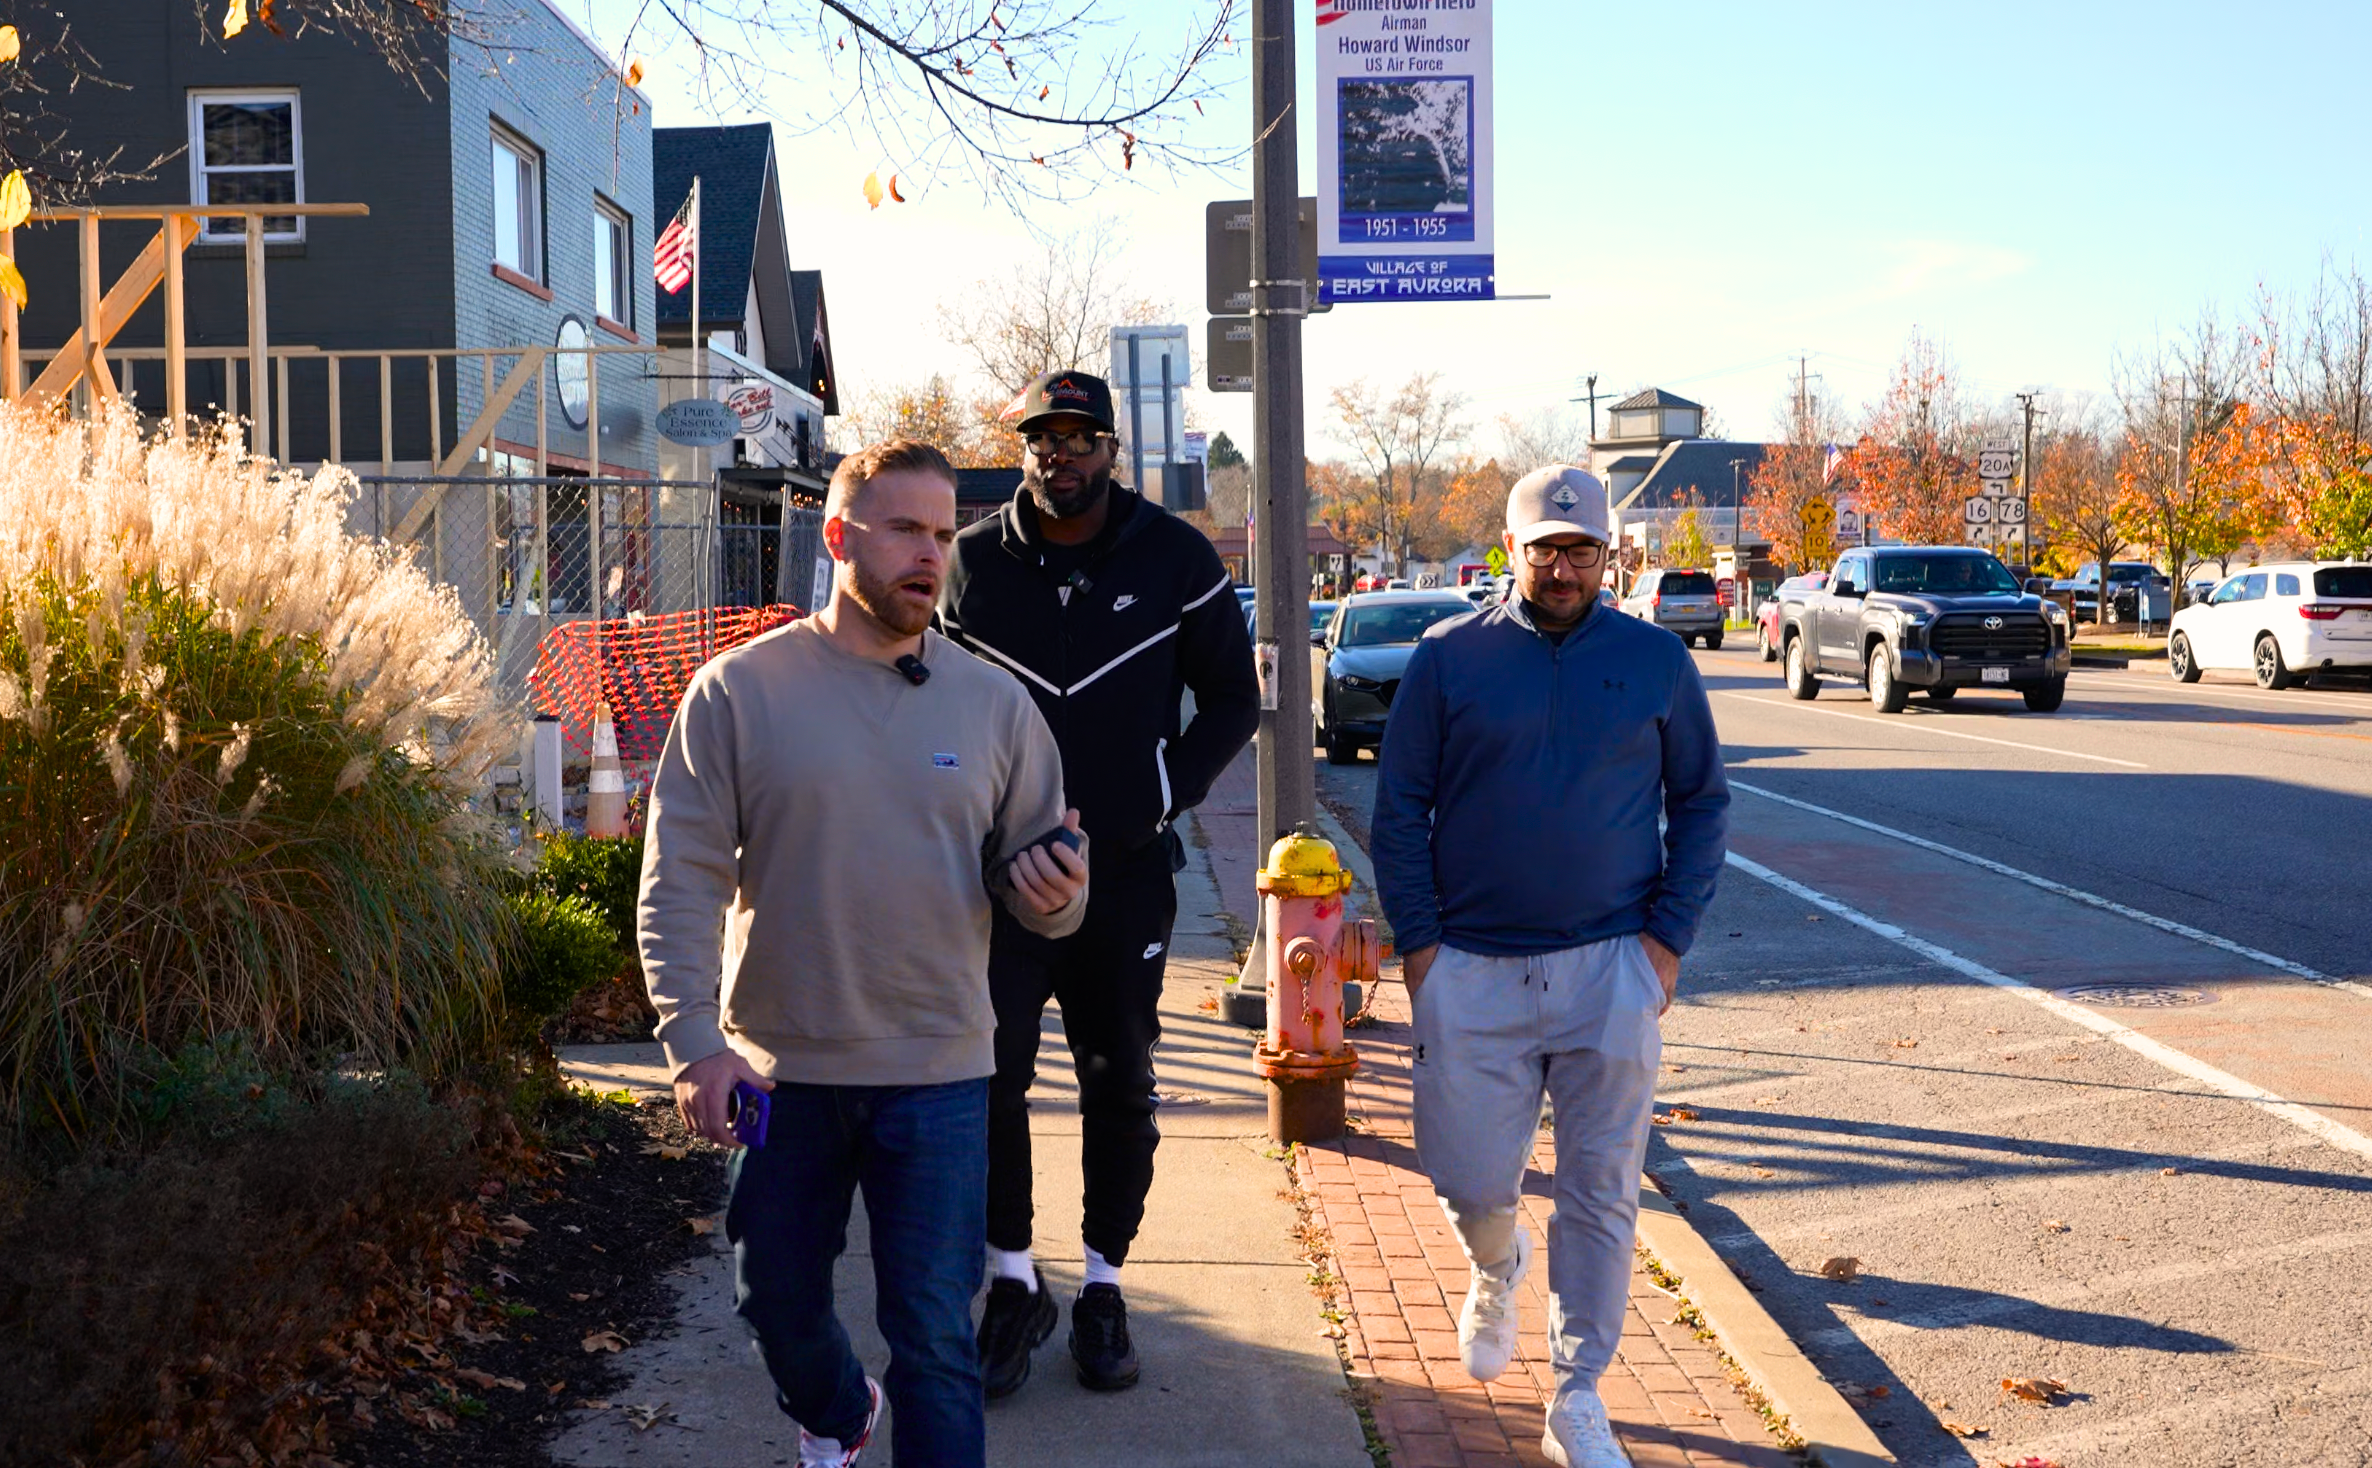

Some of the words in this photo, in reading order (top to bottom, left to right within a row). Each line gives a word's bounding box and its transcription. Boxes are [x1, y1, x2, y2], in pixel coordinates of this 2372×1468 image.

[1381, 15, 1427, 31] Airman
[1338, 36, 1399, 54] Howard
[1404, 35, 1470, 53] Windsor
[1365, 58, 1383, 71] US
[1387, 57, 1405, 71] Air
[1409, 57, 1443, 71] Force
[1365, 218, 1396, 236] 1951
[1413, 217, 1447, 236] 1955
[1365, 261, 1425, 275] VILLAGE
[1332, 278, 1390, 296] EAST
[684, 406, 714, 417] Pure
[670, 418, 727, 428] Essence
[665, 427, 697, 438] Salon
[699, 429, 706, 437] &
[711, 428, 732, 440] Spa
[1983, 458, 2010, 472] 20A
[1969, 503, 1987, 517] 16
[2001, 503, 2023, 518] 78
[1809, 536, 1824, 548] 10
